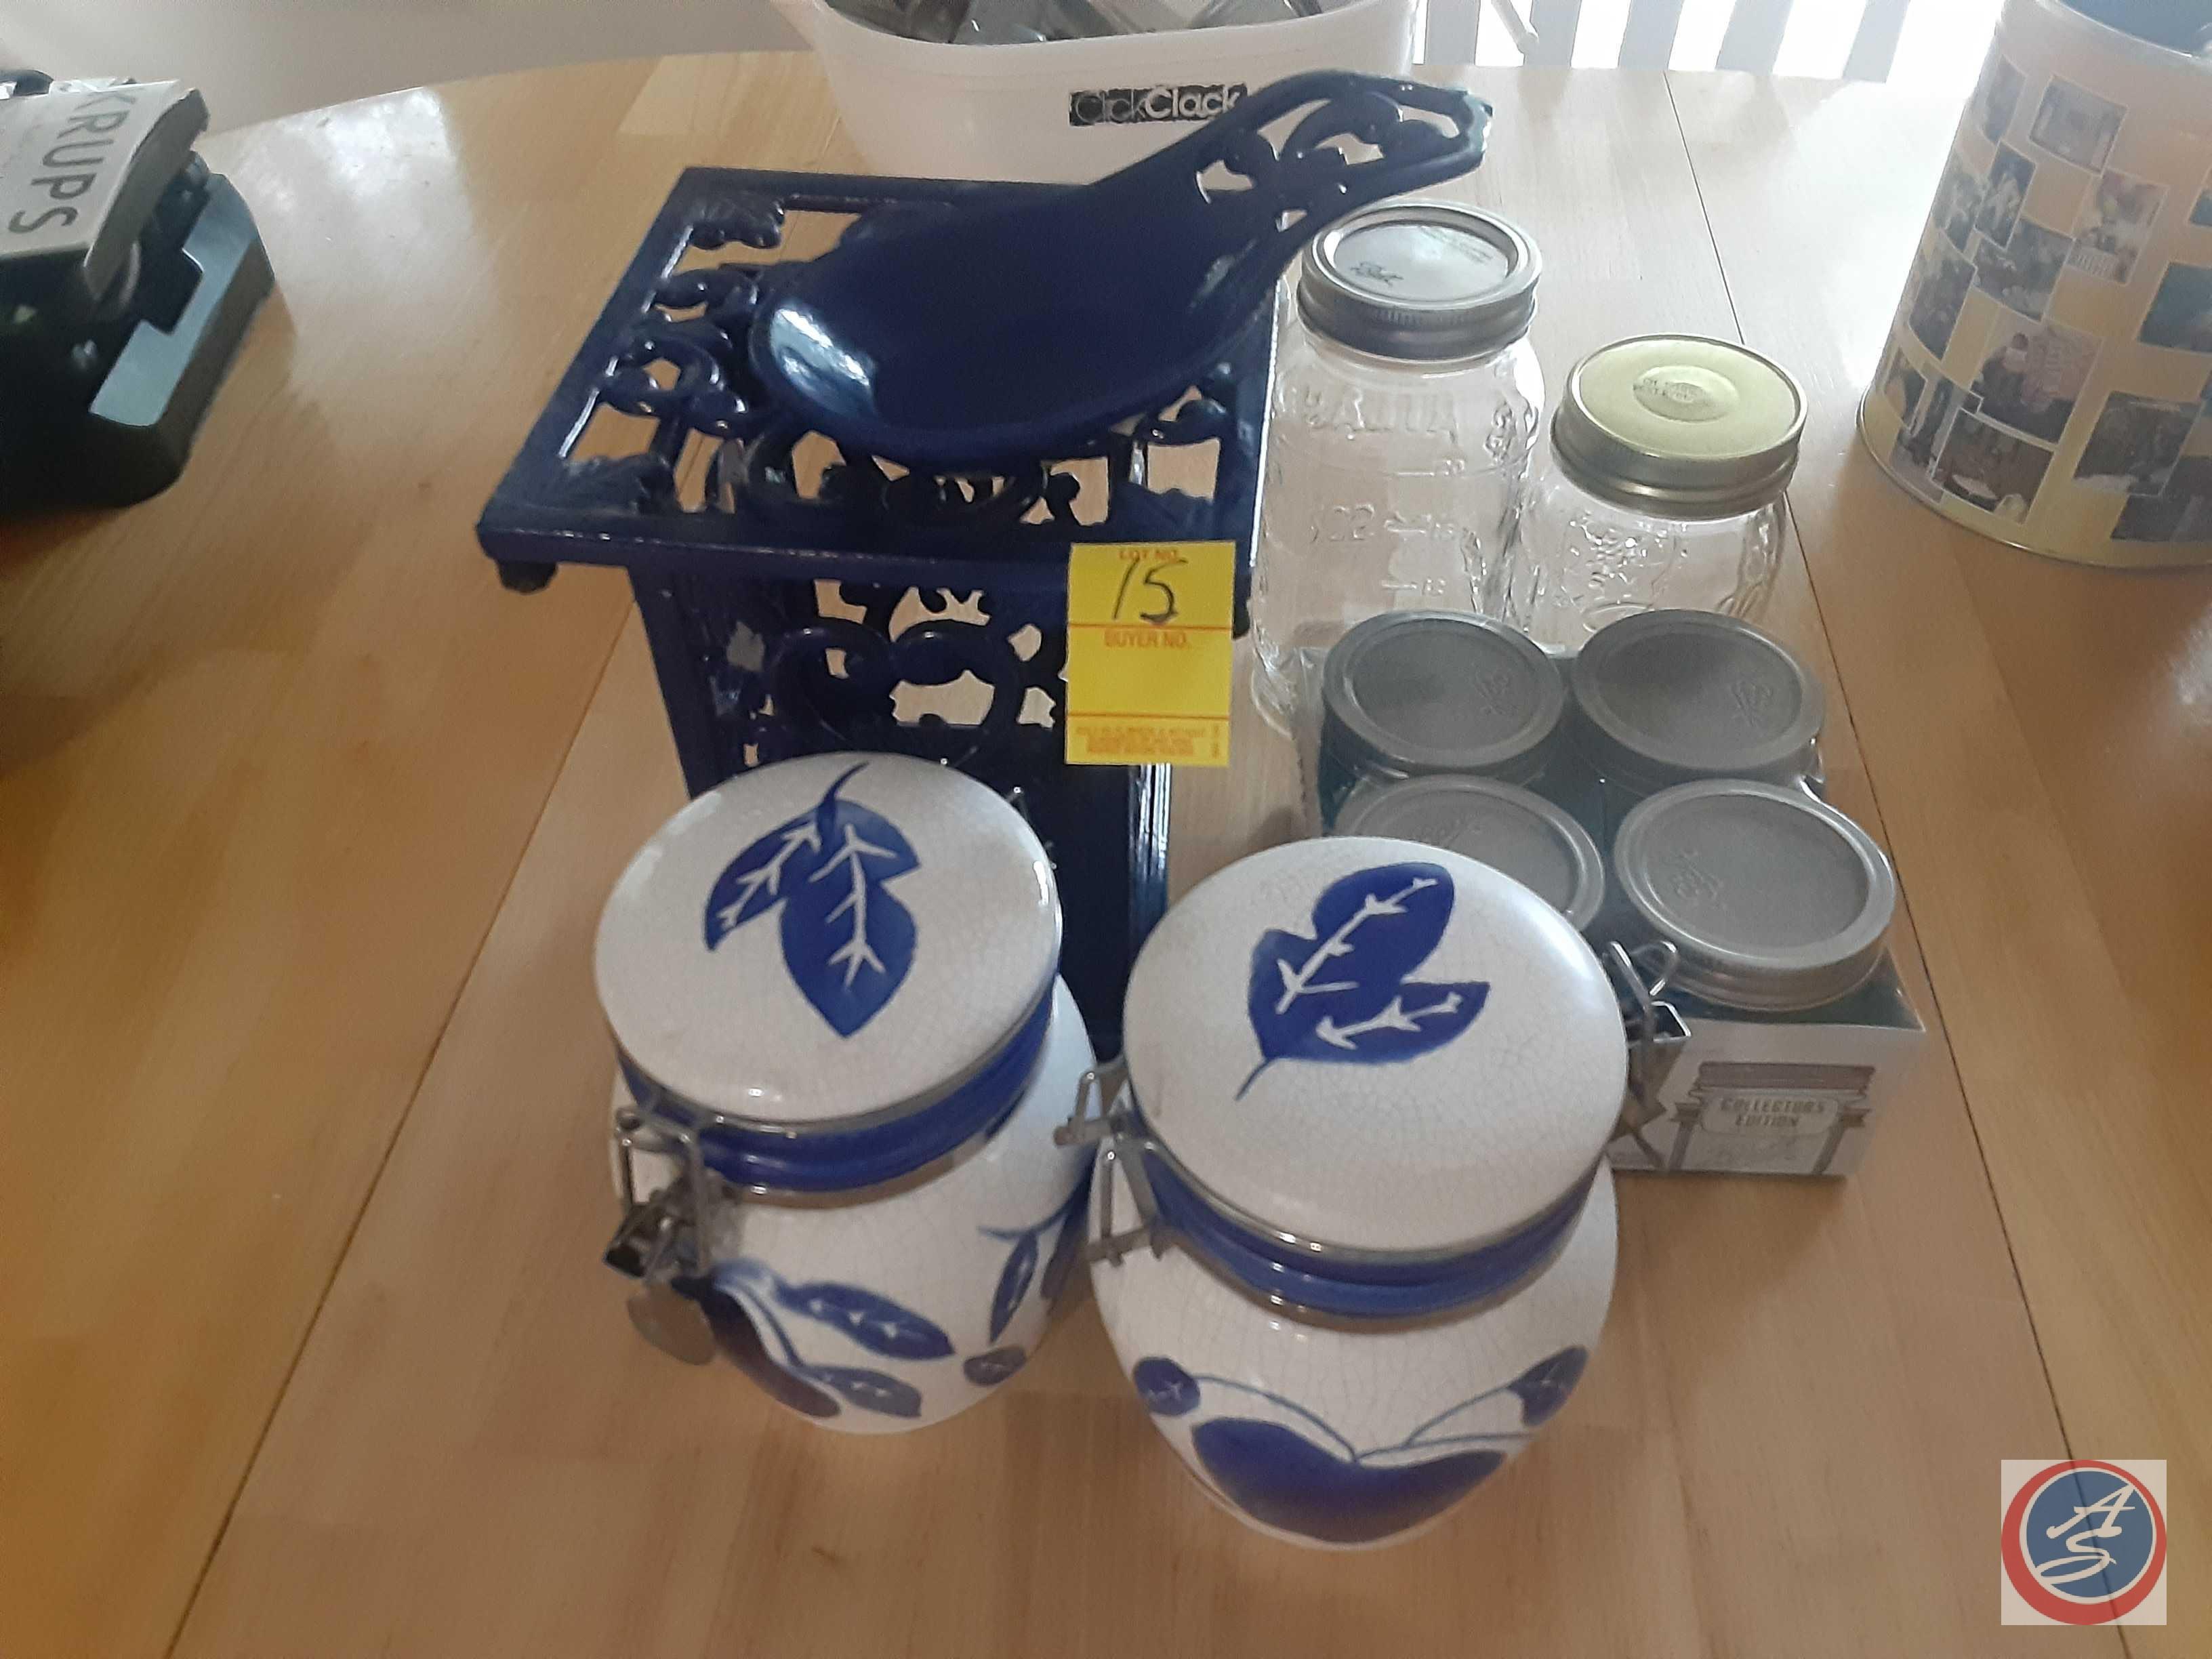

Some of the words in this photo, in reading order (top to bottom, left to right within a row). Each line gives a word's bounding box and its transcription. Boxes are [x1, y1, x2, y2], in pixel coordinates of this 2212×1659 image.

[8, 92, 138, 233] KRUPS
[1113, 554, 1189, 623] 15
[1104, 629, 1159, 647] BUYER
